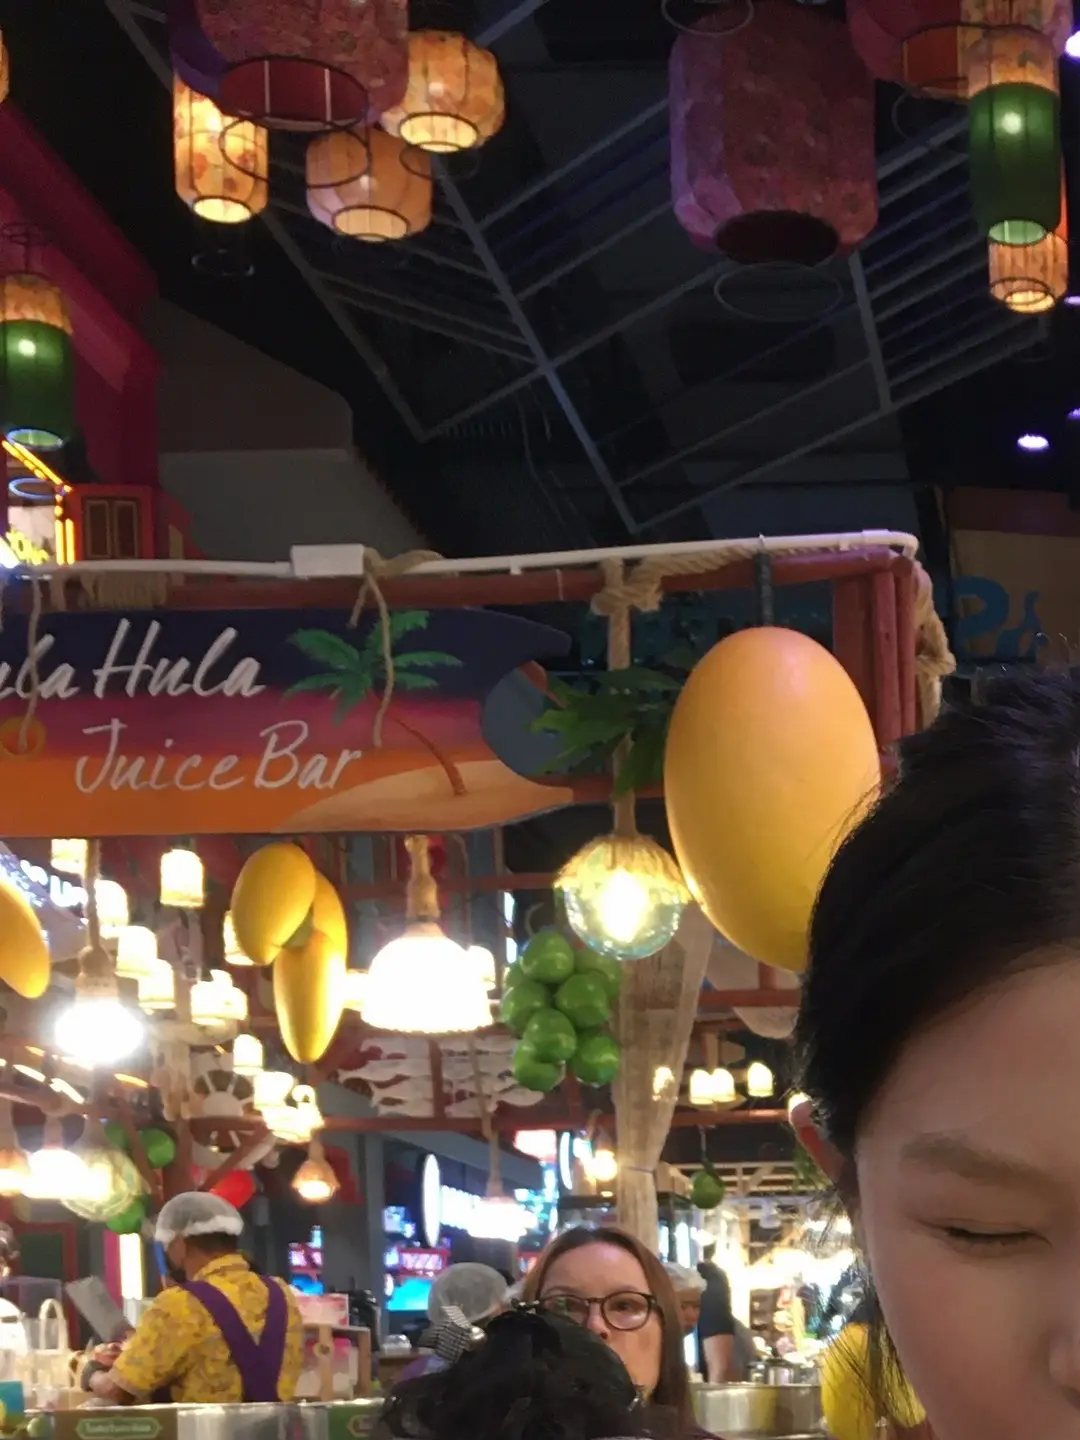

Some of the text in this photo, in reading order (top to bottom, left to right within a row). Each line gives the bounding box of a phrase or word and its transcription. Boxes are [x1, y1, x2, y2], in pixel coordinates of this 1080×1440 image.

[92, 617, 266, 699] Hula
[74, 718, 362, 793] Juice Bar
